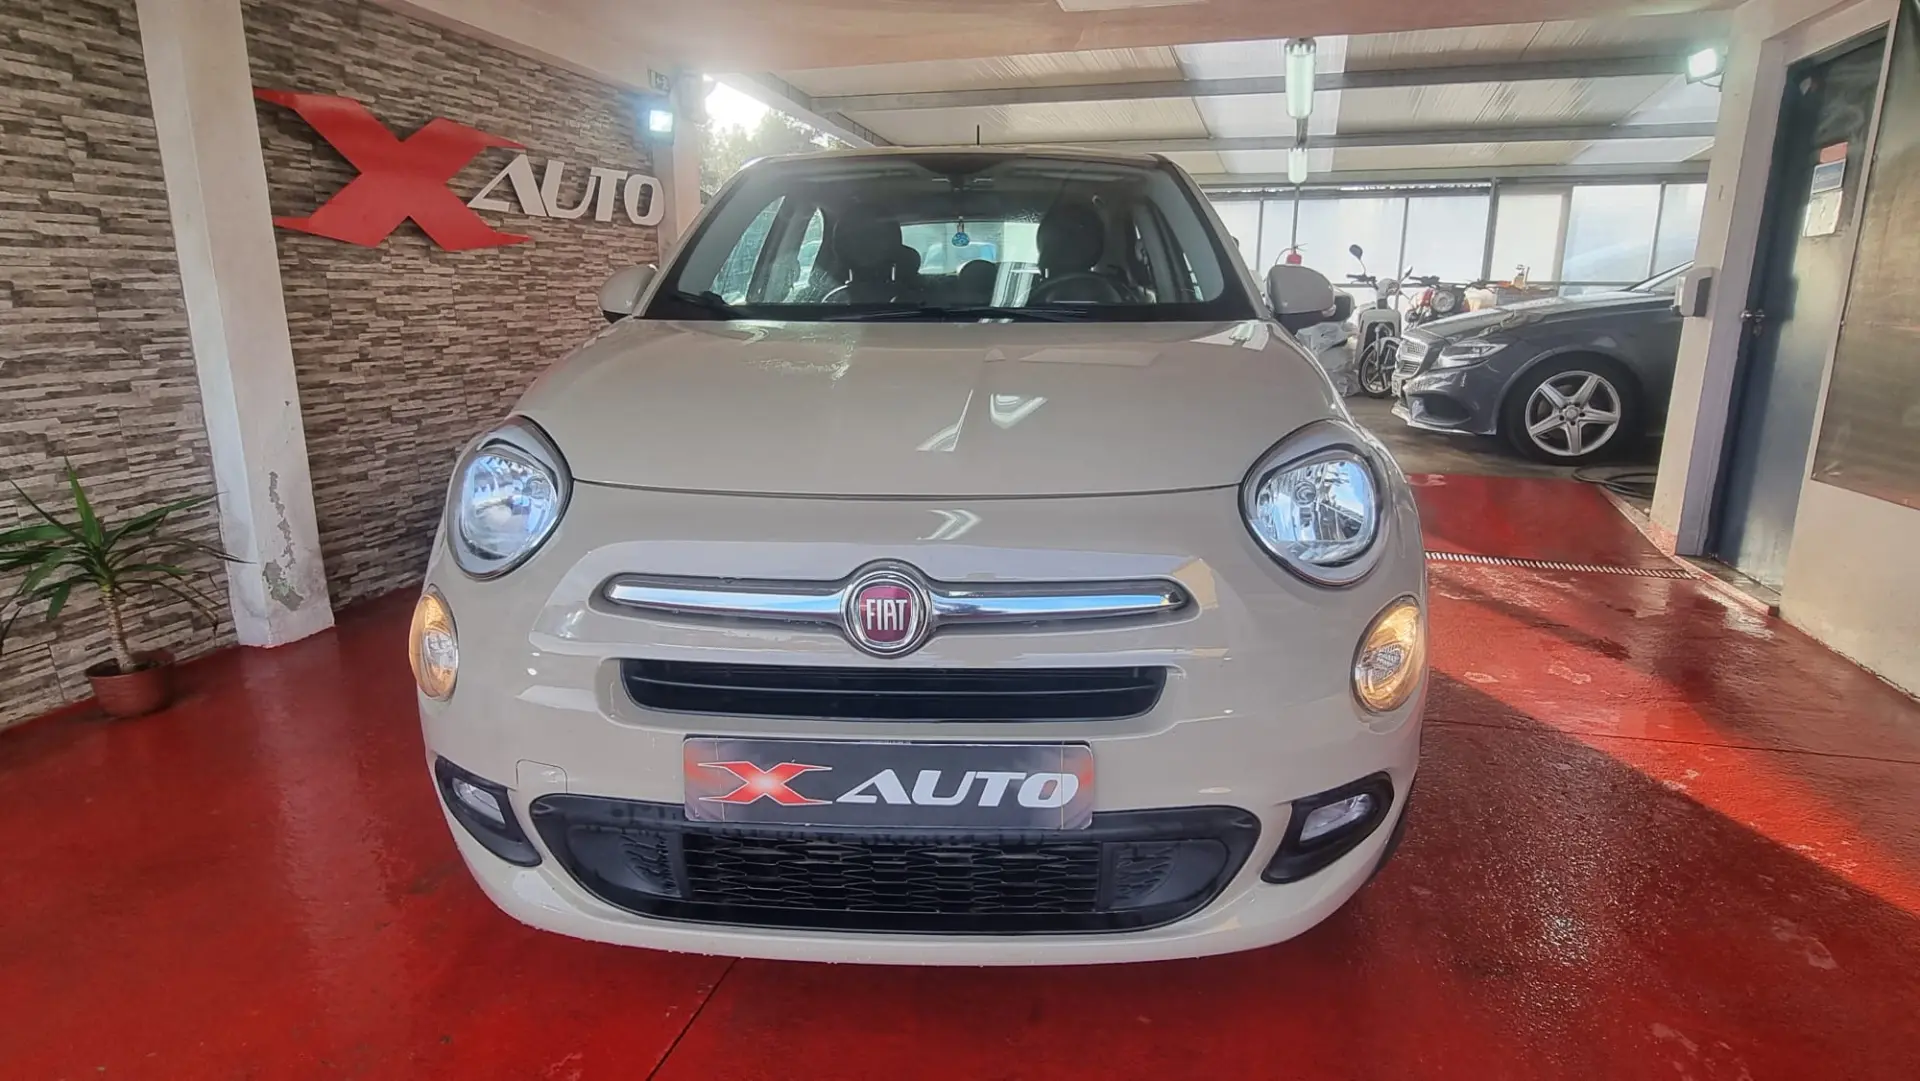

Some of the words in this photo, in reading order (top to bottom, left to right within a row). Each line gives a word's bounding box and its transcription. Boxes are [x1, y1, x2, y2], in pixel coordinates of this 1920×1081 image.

[253, 87, 534, 251] X
[467, 154, 665, 226] AUTO
[866, 598, 908, 631] FIAT
[697, 760, 833, 807] X
[836, 768, 1080, 808] AUTO
